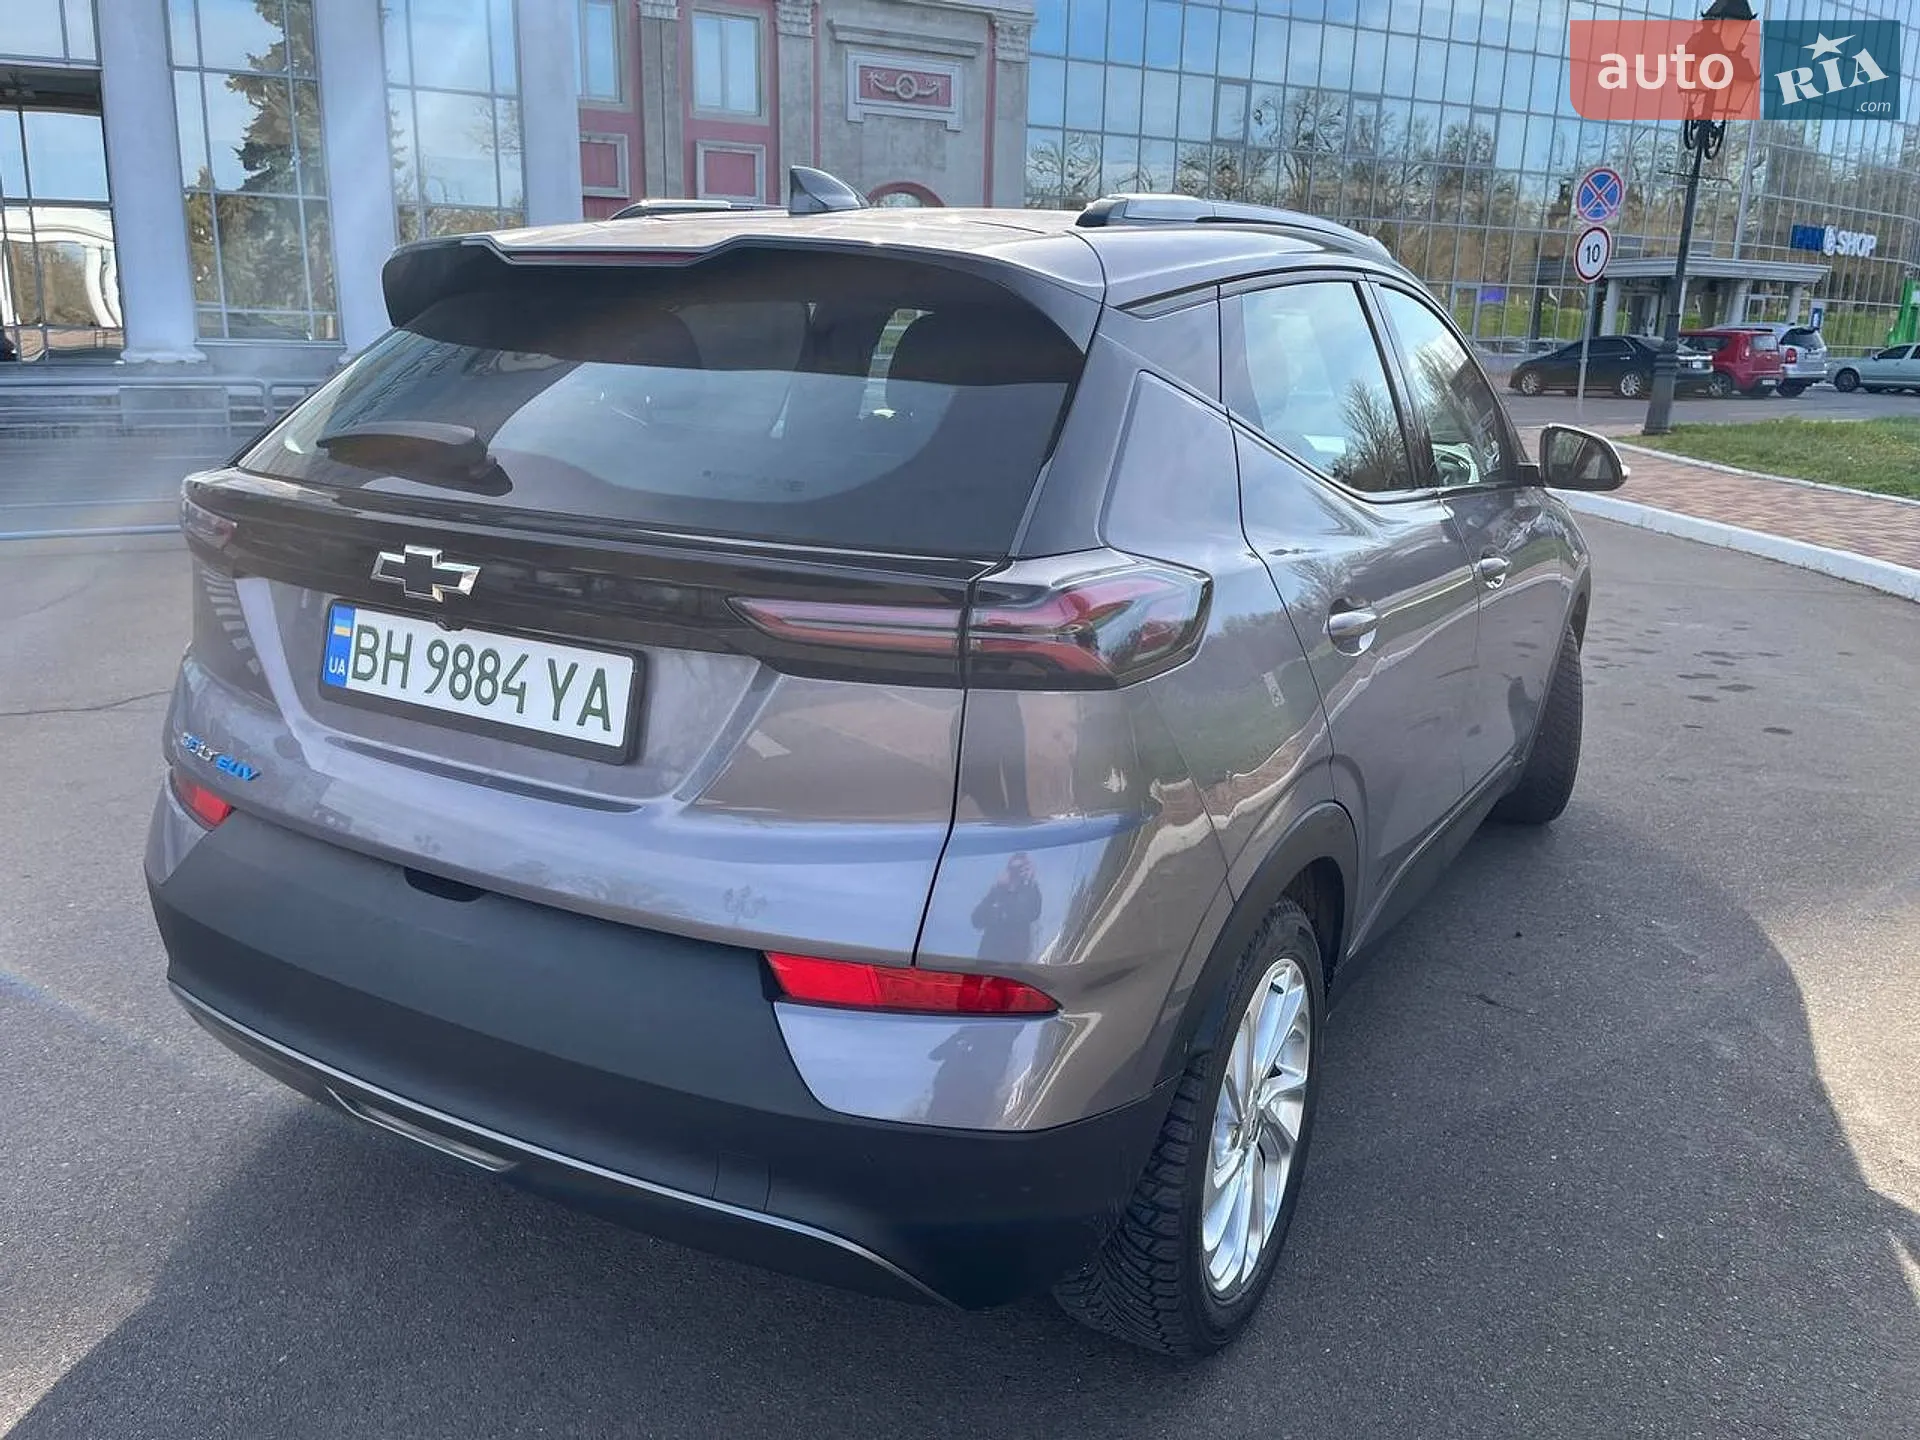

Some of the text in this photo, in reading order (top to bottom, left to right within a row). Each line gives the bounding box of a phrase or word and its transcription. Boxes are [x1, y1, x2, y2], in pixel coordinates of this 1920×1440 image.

[1586, 243, 1601, 265] 10
[328, 657, 347, 677] UA
[351, 623, 612, 733] BH 9884 YA
